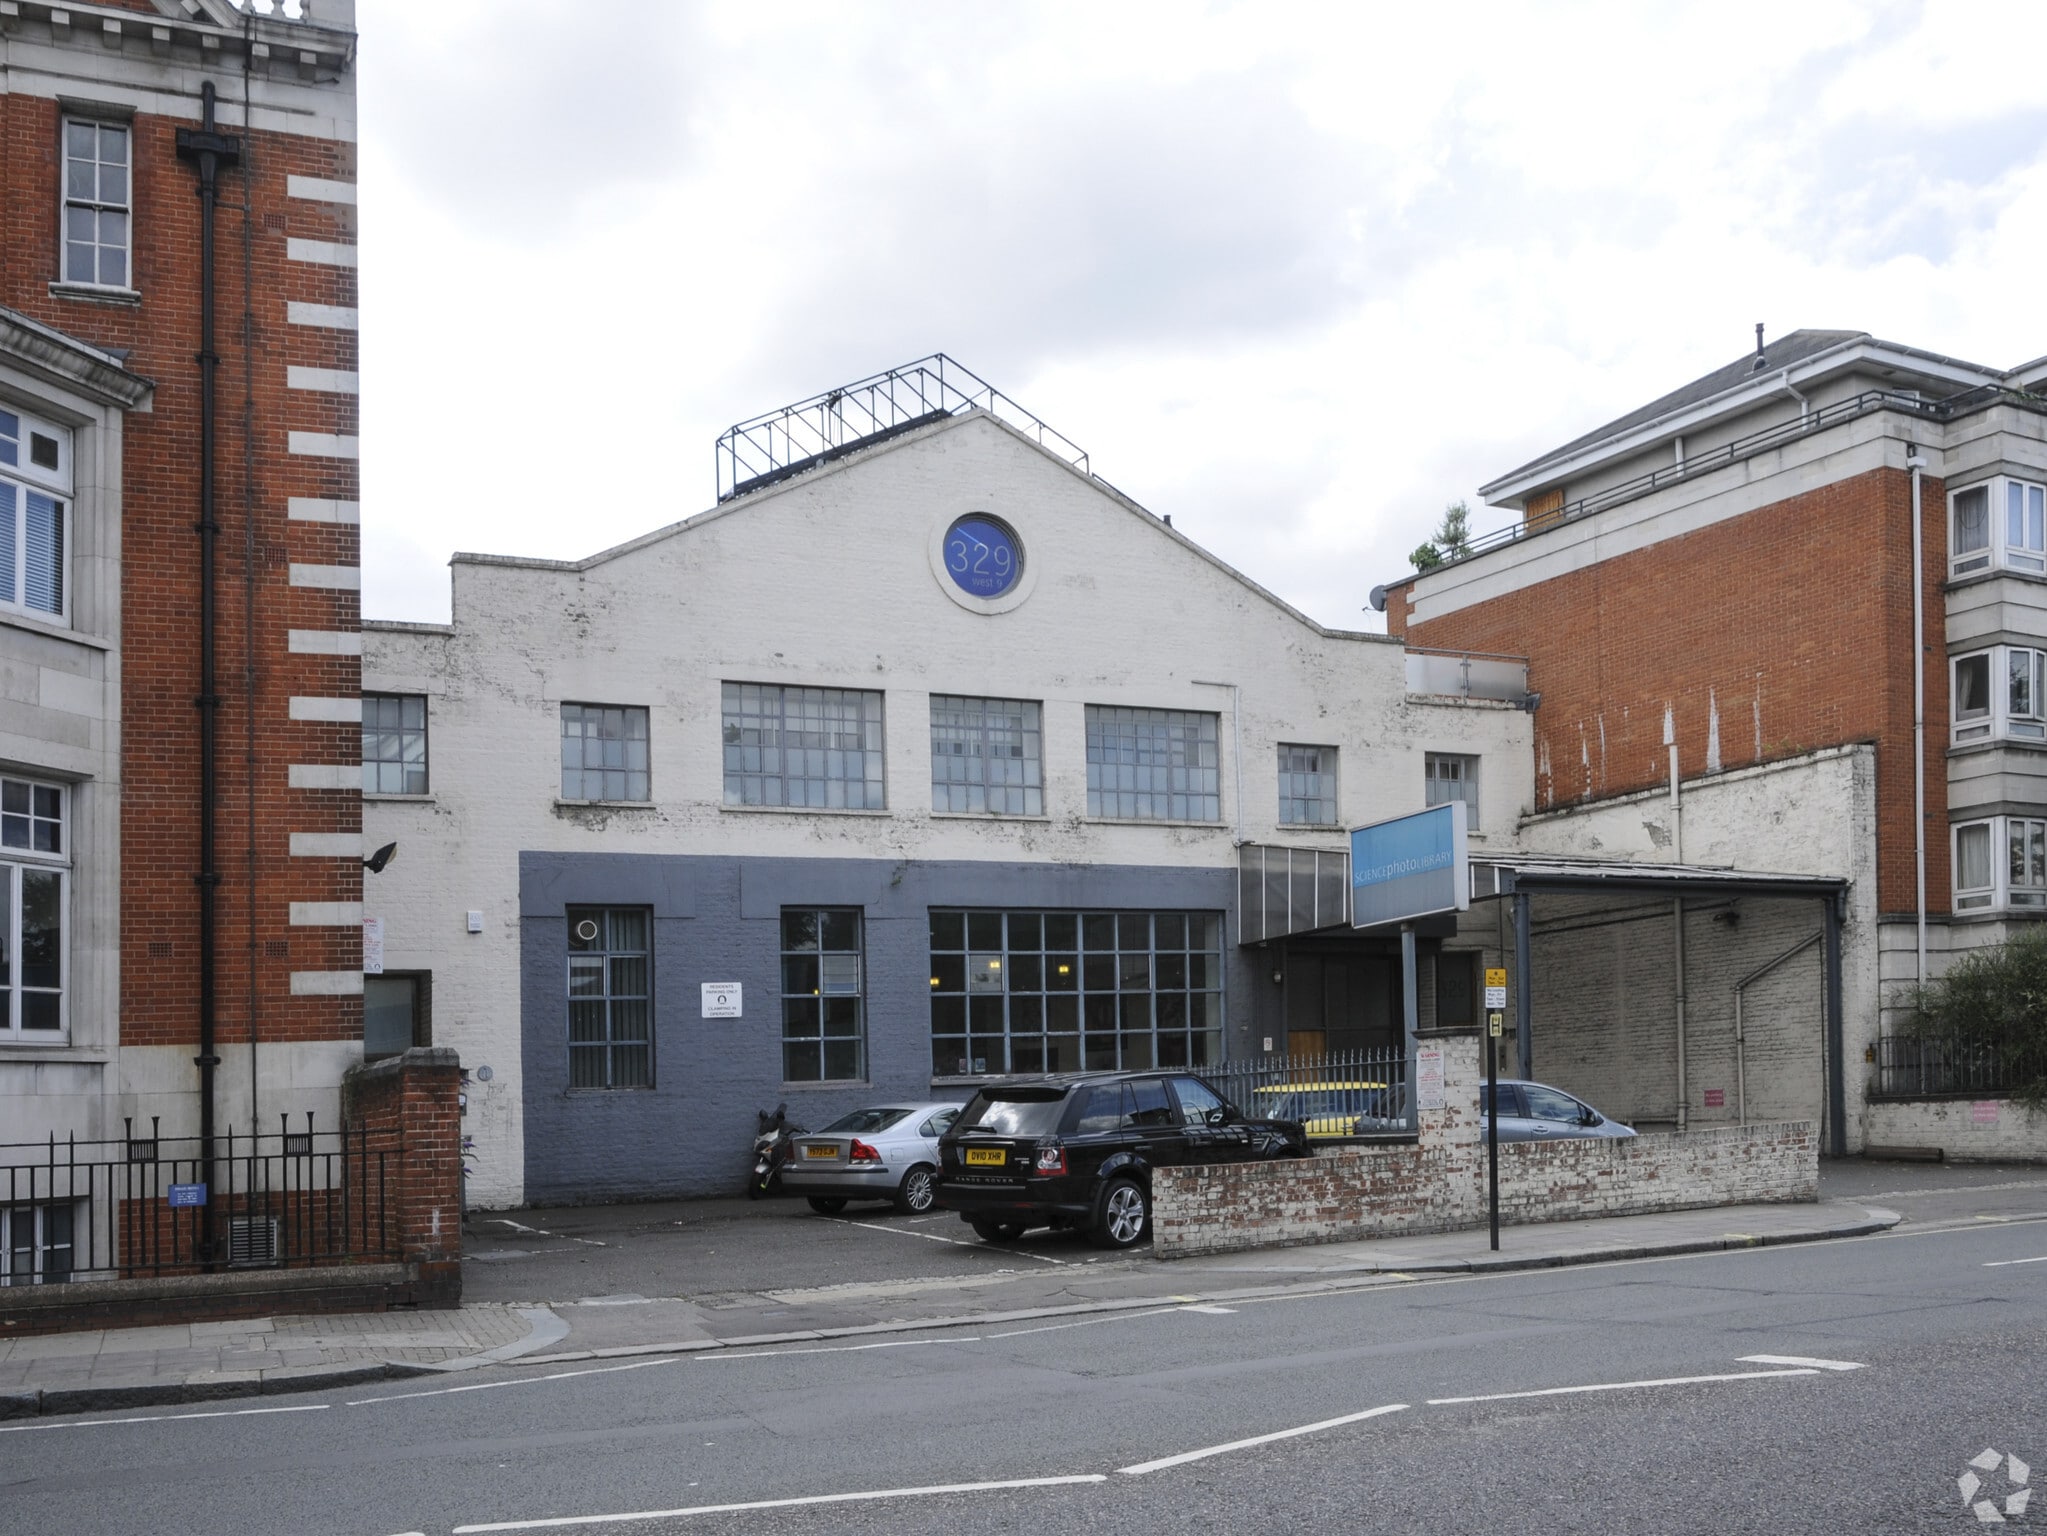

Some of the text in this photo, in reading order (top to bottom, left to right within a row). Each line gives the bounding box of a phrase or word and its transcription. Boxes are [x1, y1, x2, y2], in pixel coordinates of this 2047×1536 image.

[951, 540, 1011, 577] 329
[1492, 1016, 1500, 1034] H
[987, 1152, 1001, 1160] XHR
